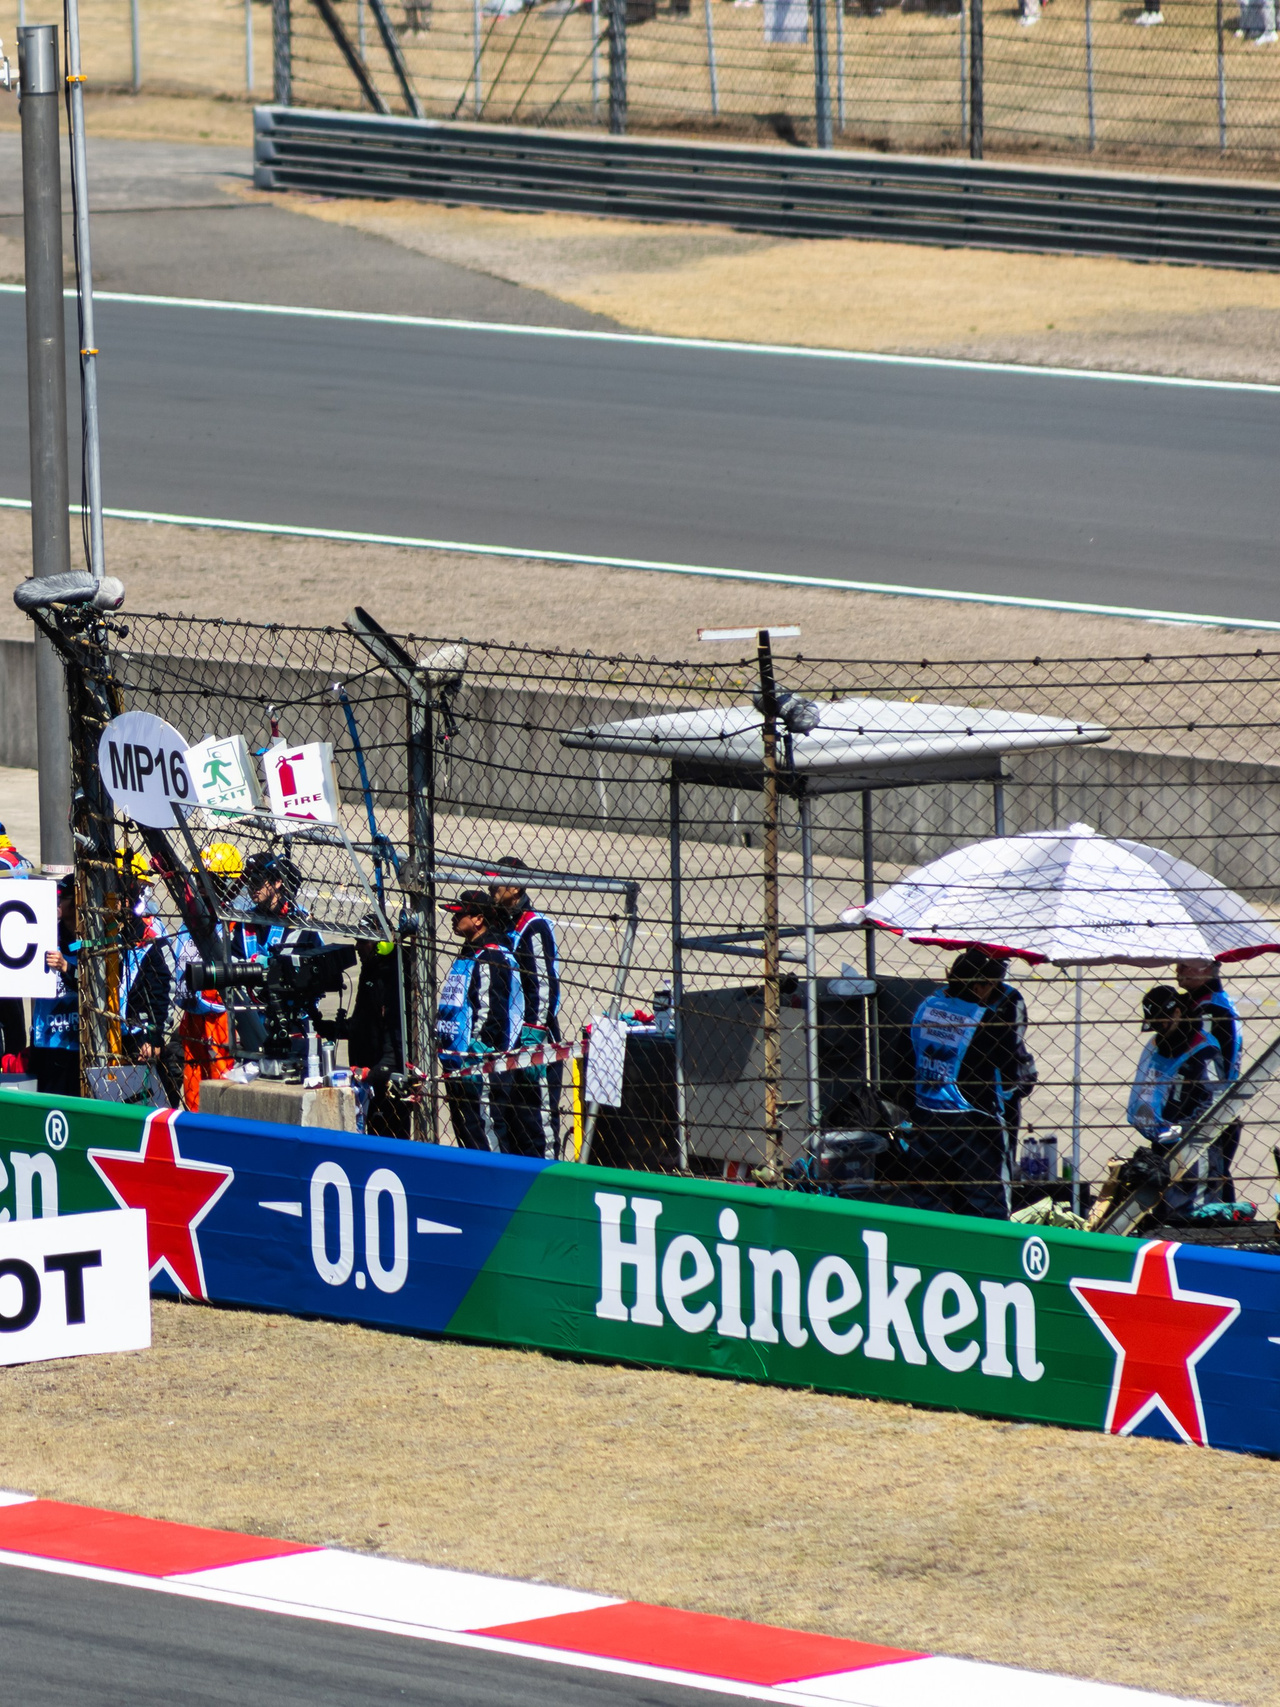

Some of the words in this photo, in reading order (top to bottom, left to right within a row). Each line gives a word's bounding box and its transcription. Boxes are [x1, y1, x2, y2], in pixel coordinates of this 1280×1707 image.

[108, 740, 189, 799] MP16
[207, 787, 247, 806] EXIT
[283, 792, 323, 809] FIRE
